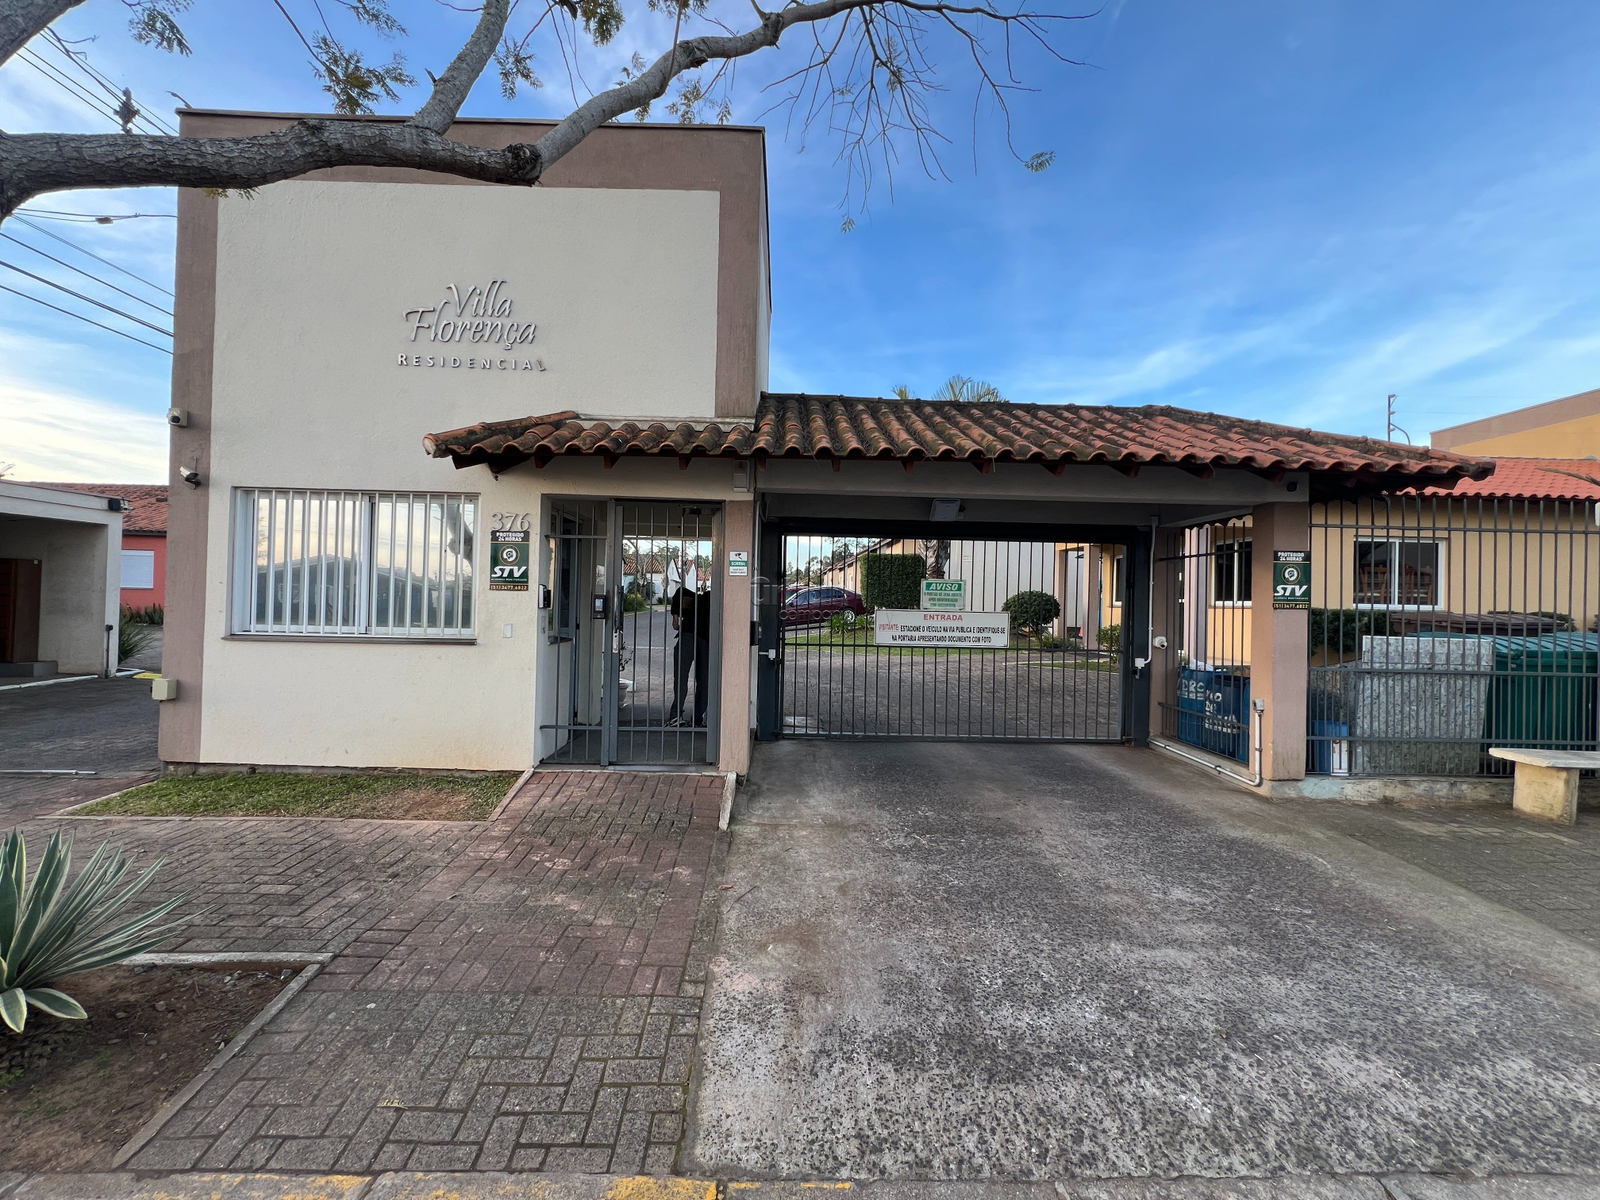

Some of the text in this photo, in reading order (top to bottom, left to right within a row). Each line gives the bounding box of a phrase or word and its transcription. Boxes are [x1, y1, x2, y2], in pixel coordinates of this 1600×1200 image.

[446, 279, 512, 318] Villa
[402, 299, 537, 350] Florença
[397, 353, 547, 372] RESIDENCIAL
[491, 511, 530, 531] 376
[491, 566, 528, 578] STV
[929, 582, 959, 591] AVISO
[1273, 585, 1308, 596] STV
[923, 613, 963, 621] ENTRADA
[878, 623, 899, 631] VISITANTE:
[900, 625, 921, 633] ESTACIONE
[942, 625, 948, 633] NA
[976, 626, 1006, 634] IDENTIFIQUE-SE
